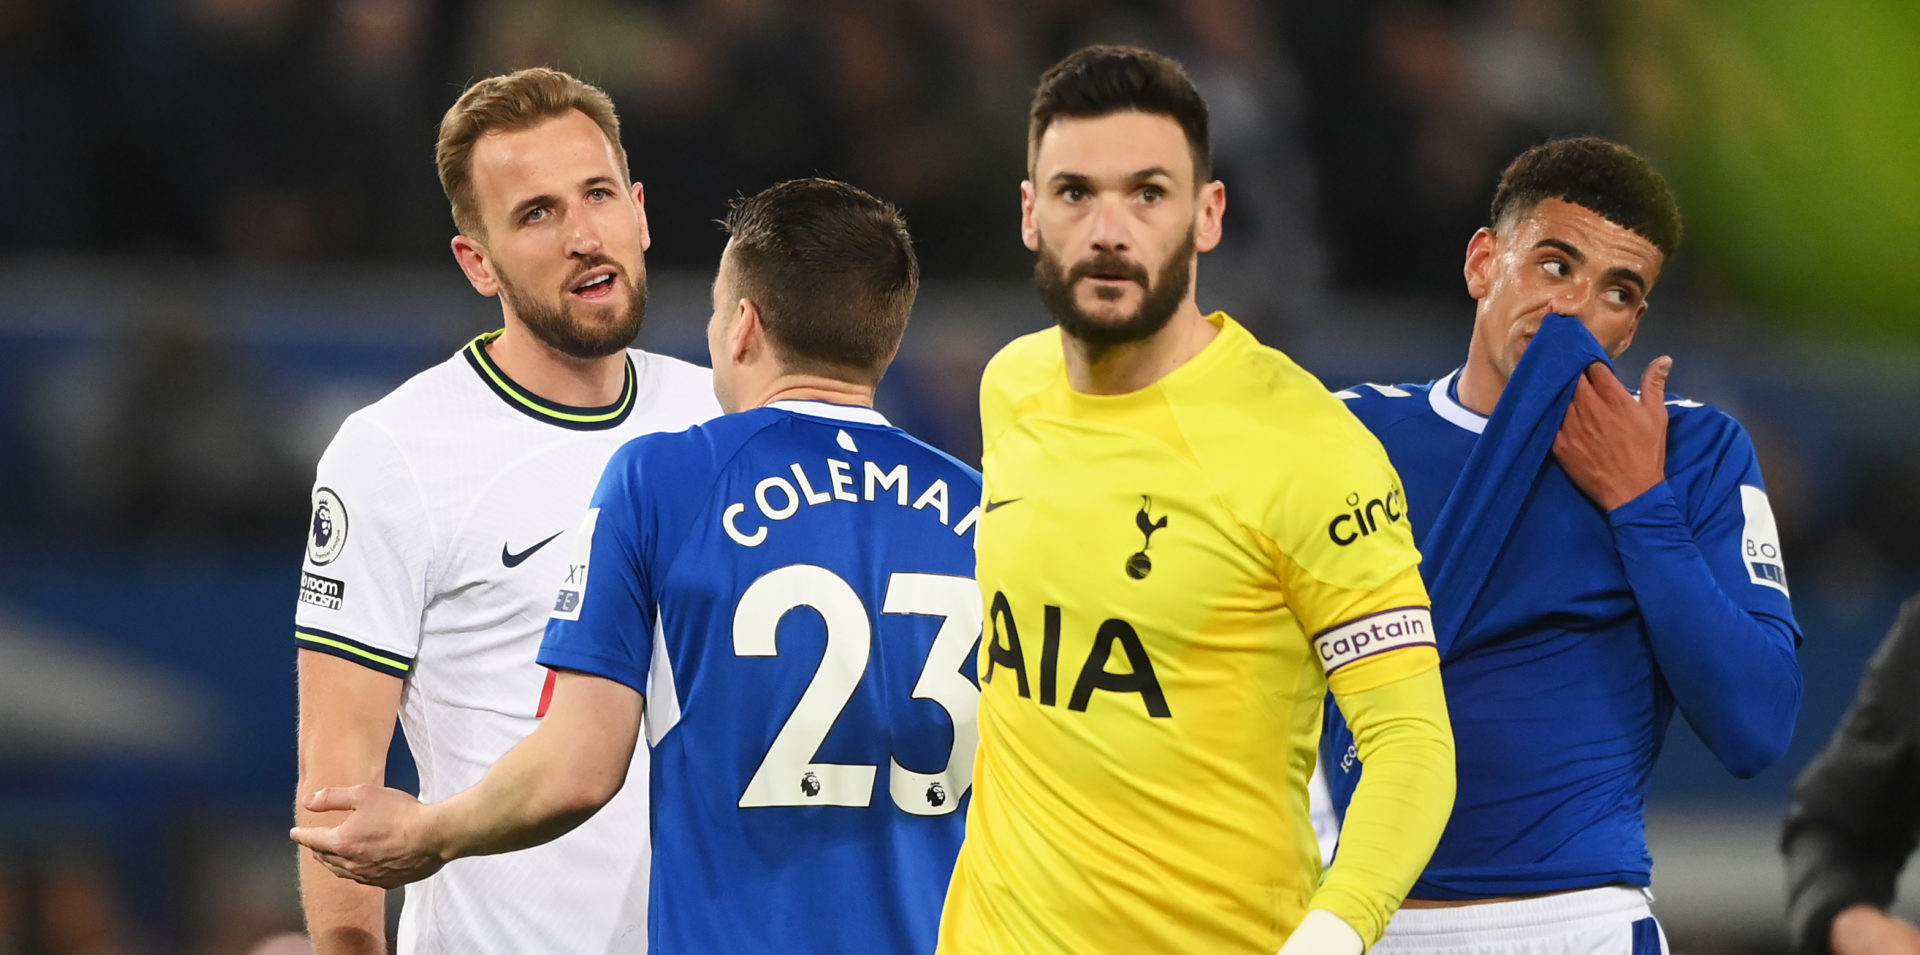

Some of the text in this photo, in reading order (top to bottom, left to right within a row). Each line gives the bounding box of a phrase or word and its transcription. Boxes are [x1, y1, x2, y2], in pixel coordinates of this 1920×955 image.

[1328, 488, 1401, 546] cinc
[1746, 538, 1777, 559] BO
[563, 564, 586, 585] XT
[981, 590, 1173, 719] AIA
[1319, 614, 1425, 662] Captain
[731, 563, 983, 817] 23
[1340, 740, 1358, 774] ECO
